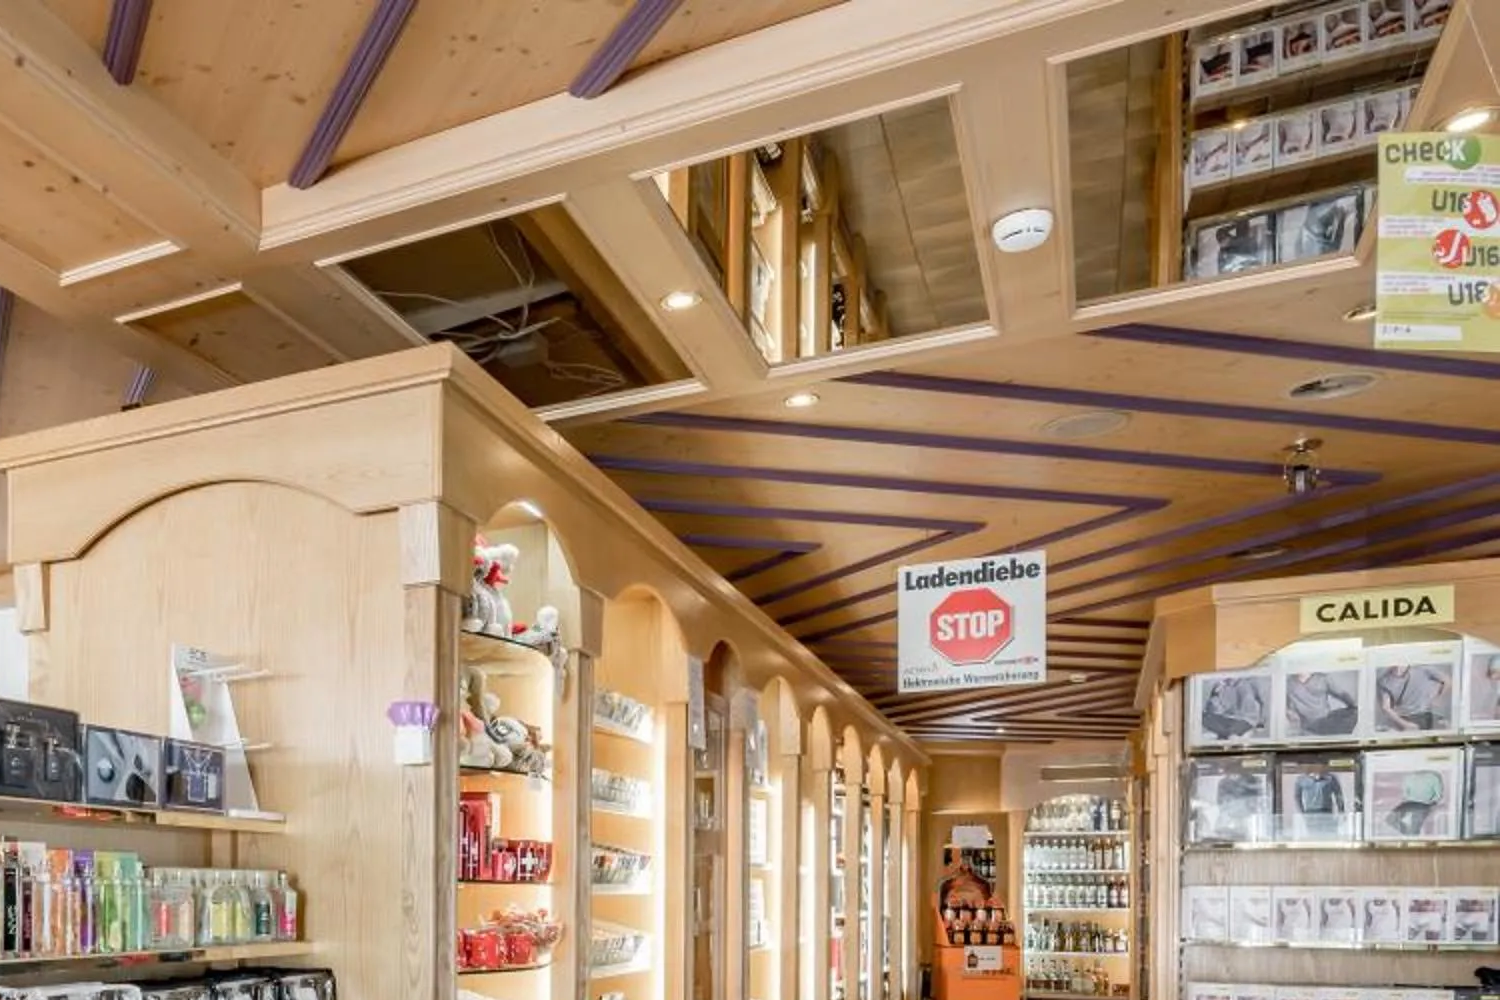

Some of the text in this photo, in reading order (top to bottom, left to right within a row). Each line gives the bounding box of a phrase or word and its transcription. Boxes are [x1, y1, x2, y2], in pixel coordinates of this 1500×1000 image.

[905, 557, 1041, 591] Ladendiebe
[936, 609, 1005, 642] STOP
[1315, 595, 1437, 624] CALIDA
